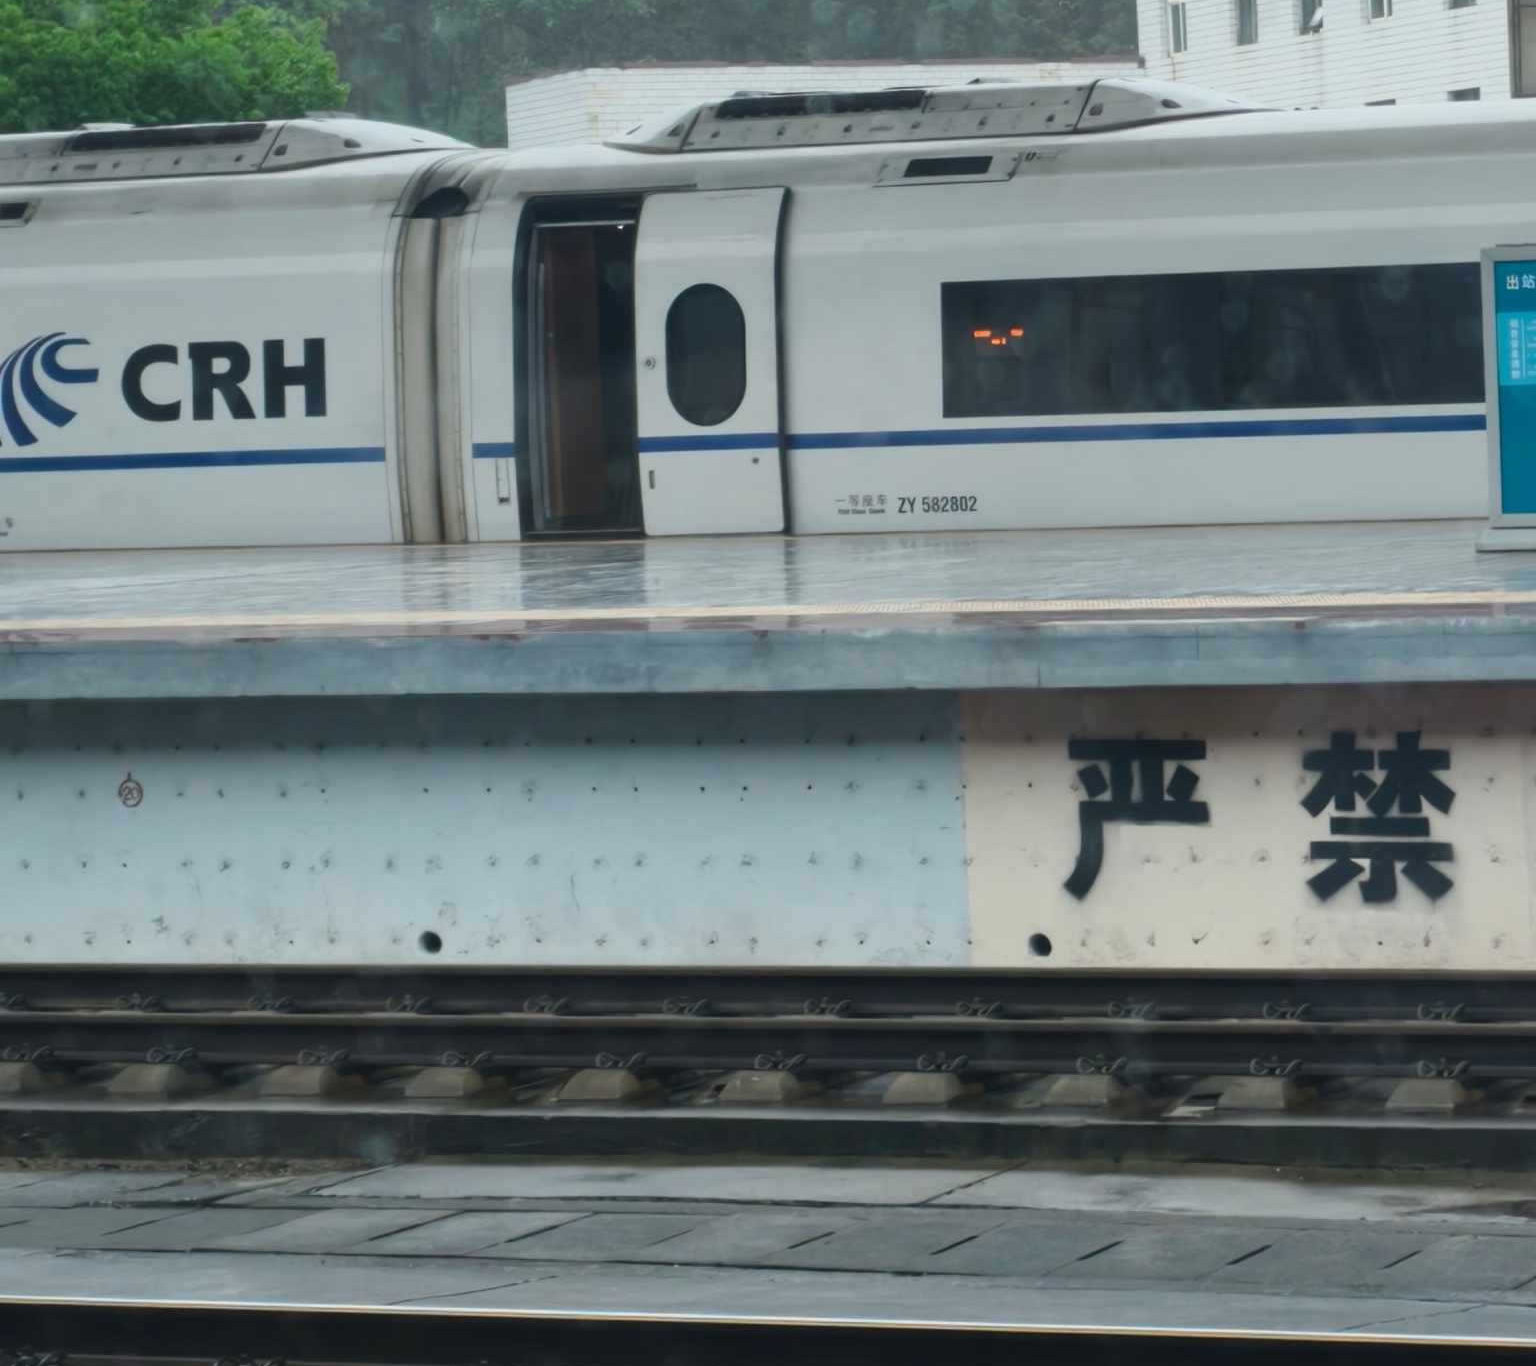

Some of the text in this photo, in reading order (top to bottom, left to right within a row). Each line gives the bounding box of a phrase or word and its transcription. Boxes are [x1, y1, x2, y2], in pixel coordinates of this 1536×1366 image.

[121, 338, 327, 423] CRH
[897, 497, 917, 514] ZY
[922, 495, 978, 513] 582802
